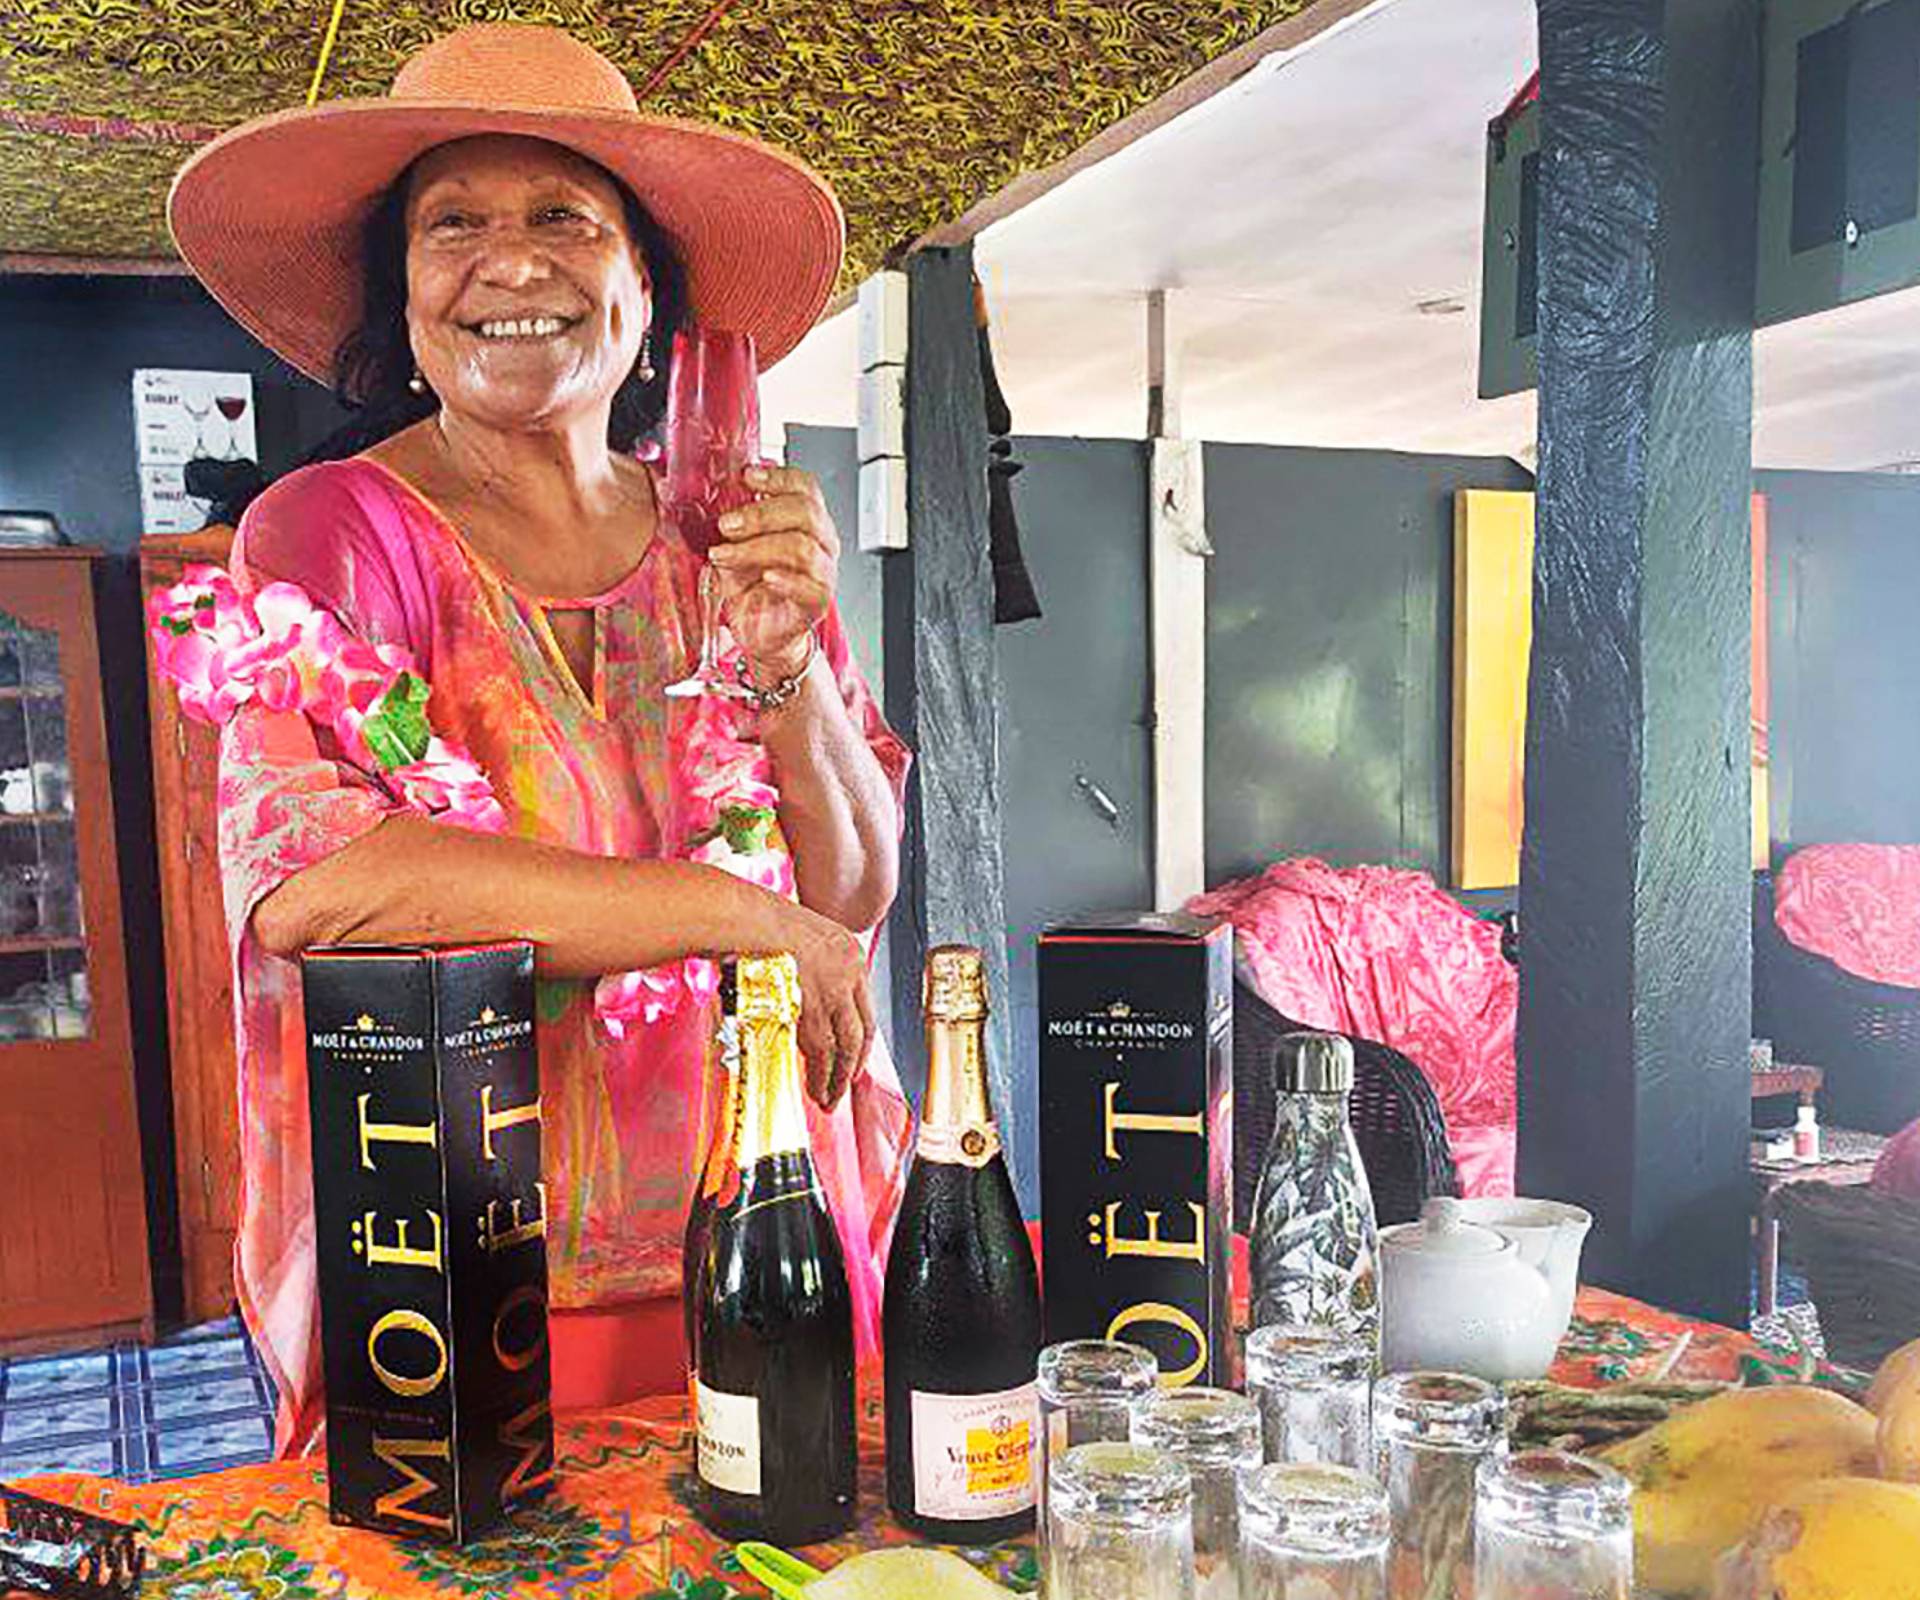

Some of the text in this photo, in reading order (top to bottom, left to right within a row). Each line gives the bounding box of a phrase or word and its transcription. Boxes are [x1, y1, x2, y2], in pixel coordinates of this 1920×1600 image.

[359, 1035, 424, 1051] CHANDON
[1110, 1022, 1194, 1038] CHANDON
[350, 1092, 455, 1537] MOËT
[1087, 1080, 1208, 1389] OËT
